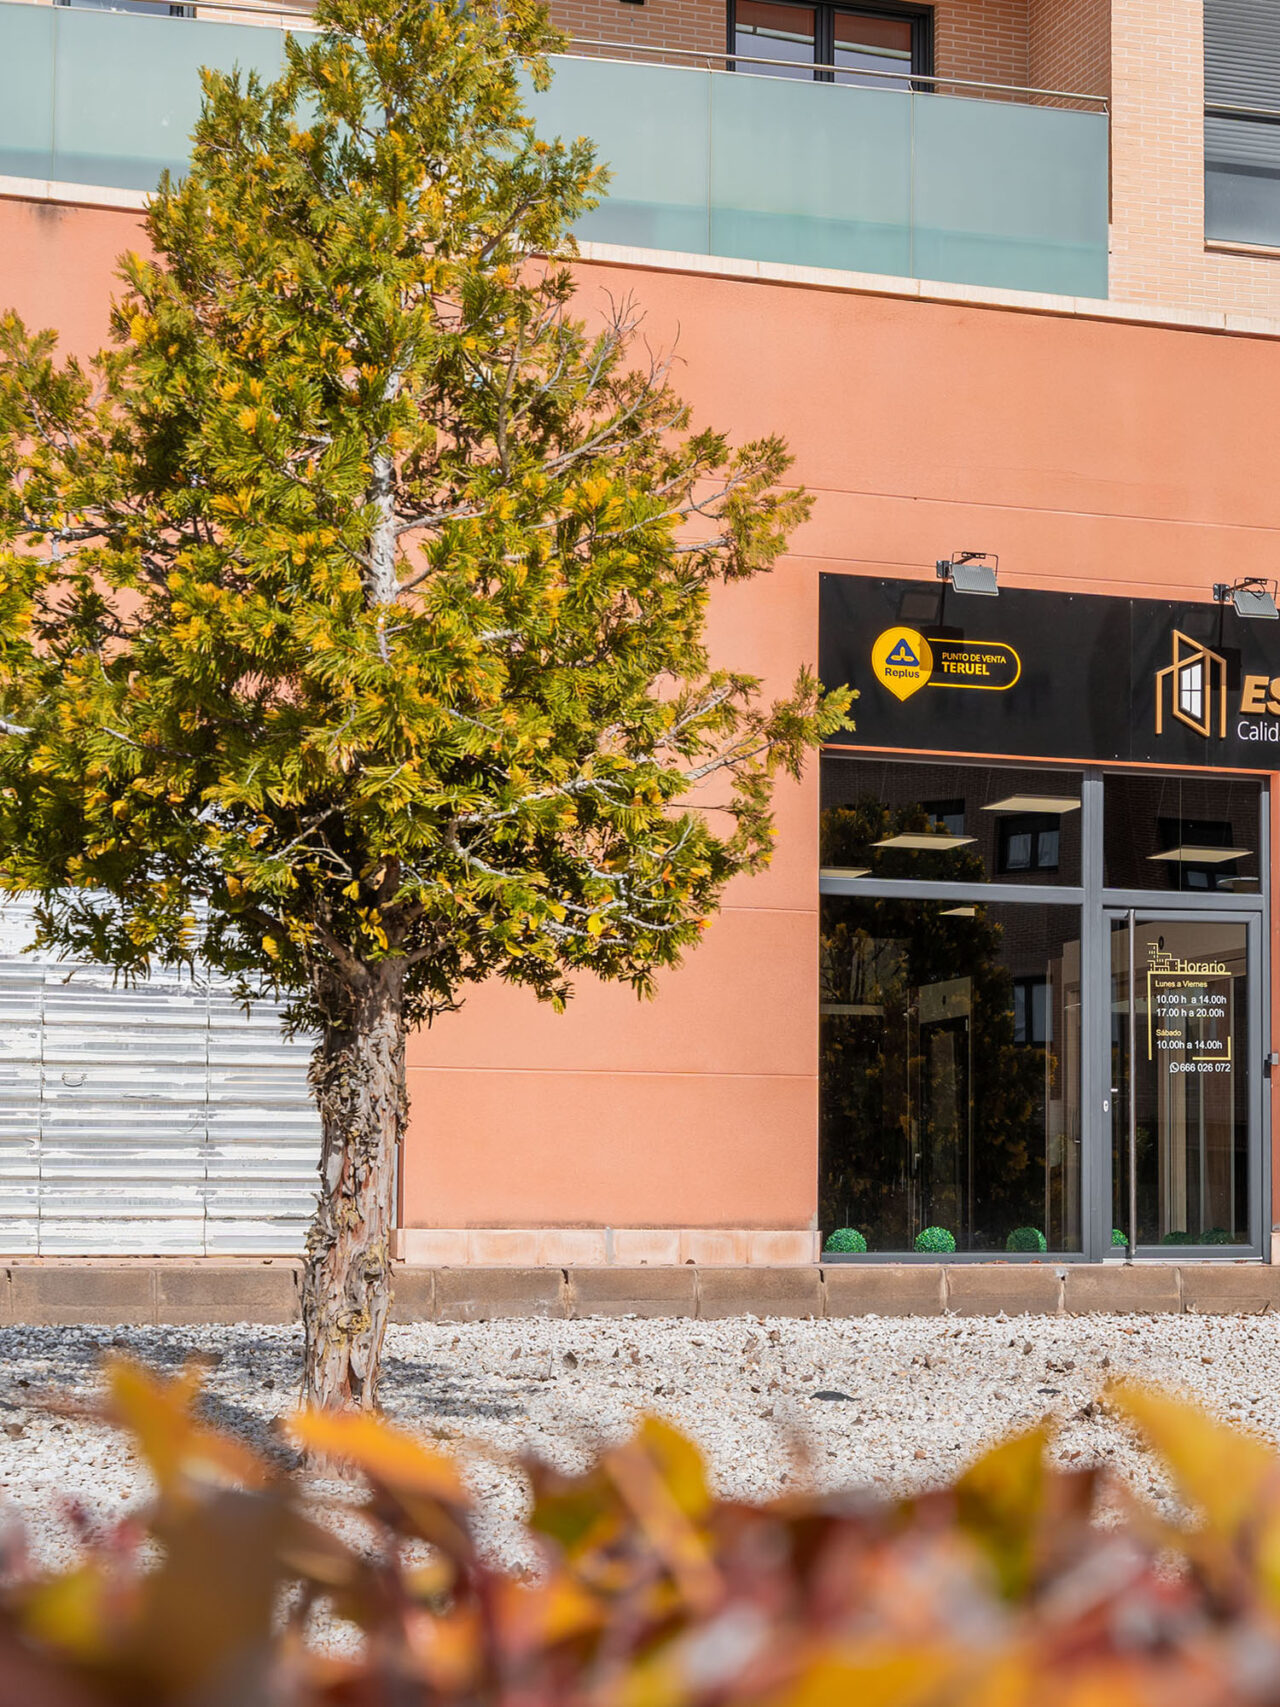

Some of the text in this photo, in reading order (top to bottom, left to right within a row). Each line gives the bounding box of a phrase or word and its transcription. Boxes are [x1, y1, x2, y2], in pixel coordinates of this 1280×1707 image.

[942, 652, 1006, 664] PUNTO DE VENTA
[885, 667, 920, 678] Replus
[942, 661, 990, 676] TERUEL
[1178, 960, 1226, 973] Horario
[1155, 980, 1176, 988] Lunes
[1183, 980, 1208, 988] Viernes
[1156, 995, 1179, 1004] 10.00
[1199, 995, 1227, 1004] 14.00h
[1156, 1009, 1179, 1017] 17.00
[1196, 1009, 1225, 1018] 20.00h
[1156, 1029, 1182, 1037] Sábado
[1156, 1040, 1185, 1050] 10.00h
[1194, 1040, 1223, 1050] 14.00h
[1179, 1063, 1231, 1073] 666 026 072
